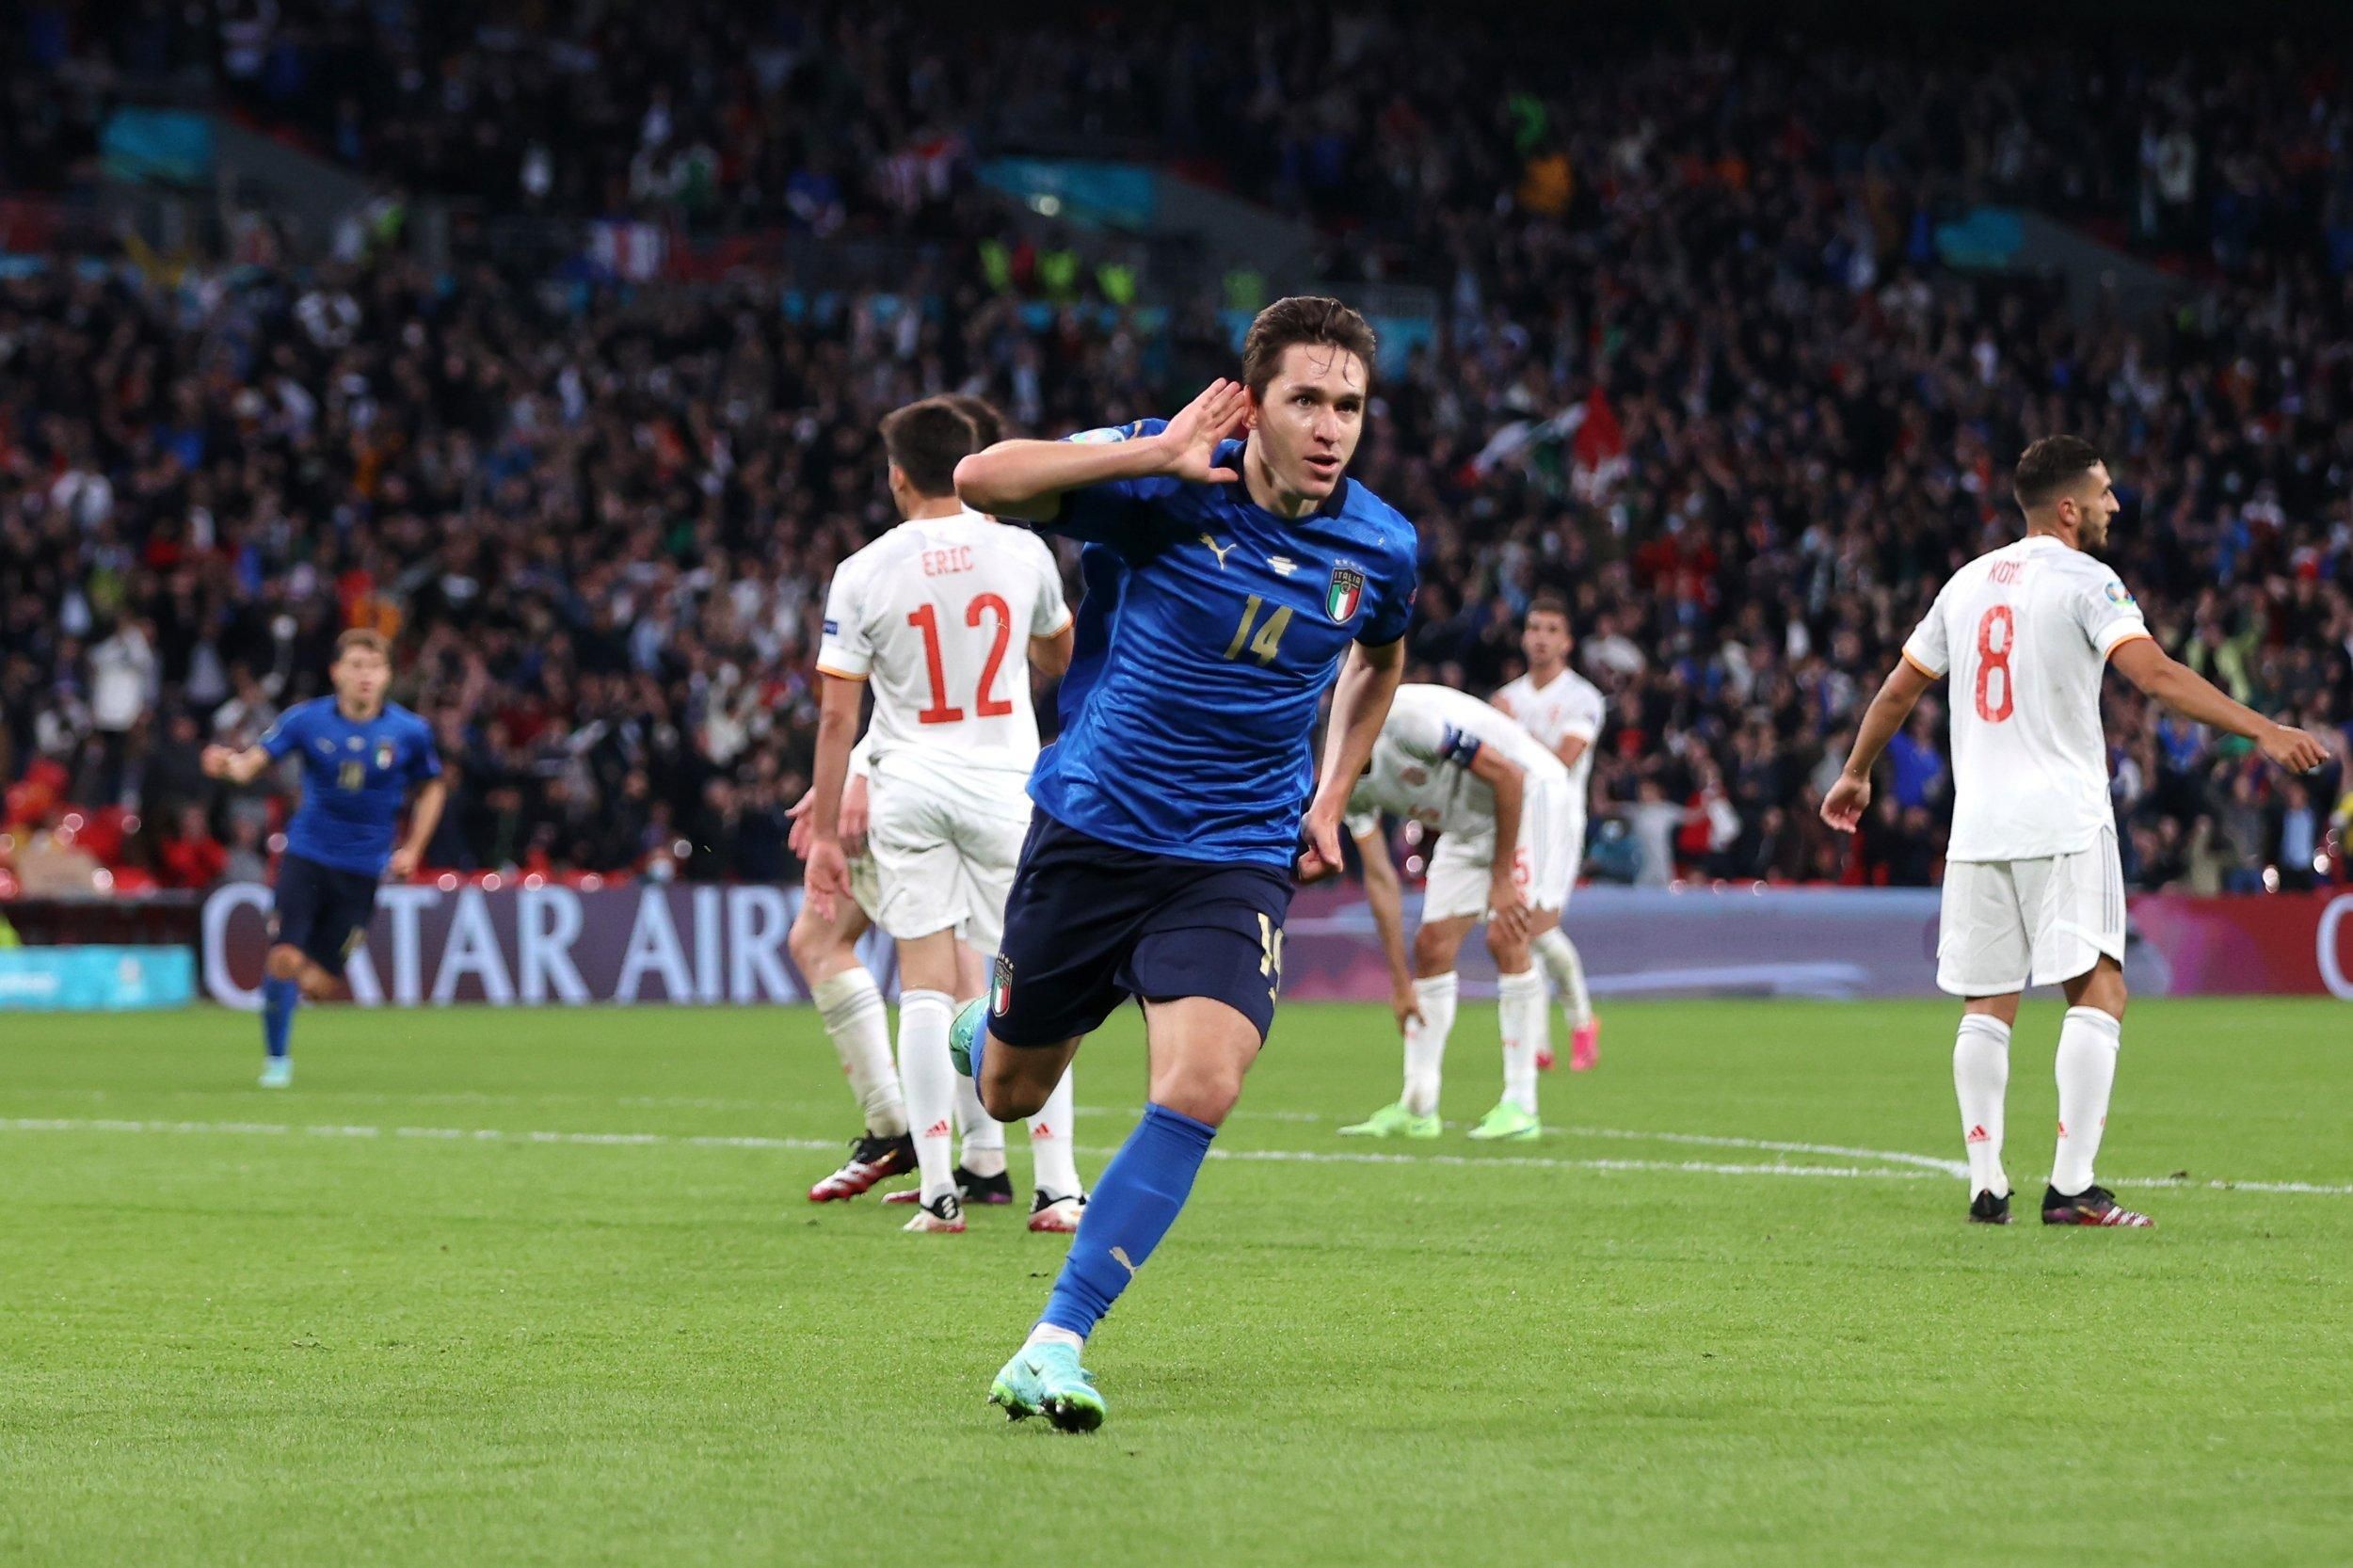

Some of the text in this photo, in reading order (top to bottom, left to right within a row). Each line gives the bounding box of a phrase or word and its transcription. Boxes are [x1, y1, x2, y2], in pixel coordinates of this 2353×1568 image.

[922, 546, 973, 576] ERIC
[1334, 570, 1361, 584] ITALIA
[1987, 560, 2027, 585] KO
[1223, 593, 1294, 664] 14
[908, 591, 1013, 724] 12
[1976, 605, 2014, 723] 8
